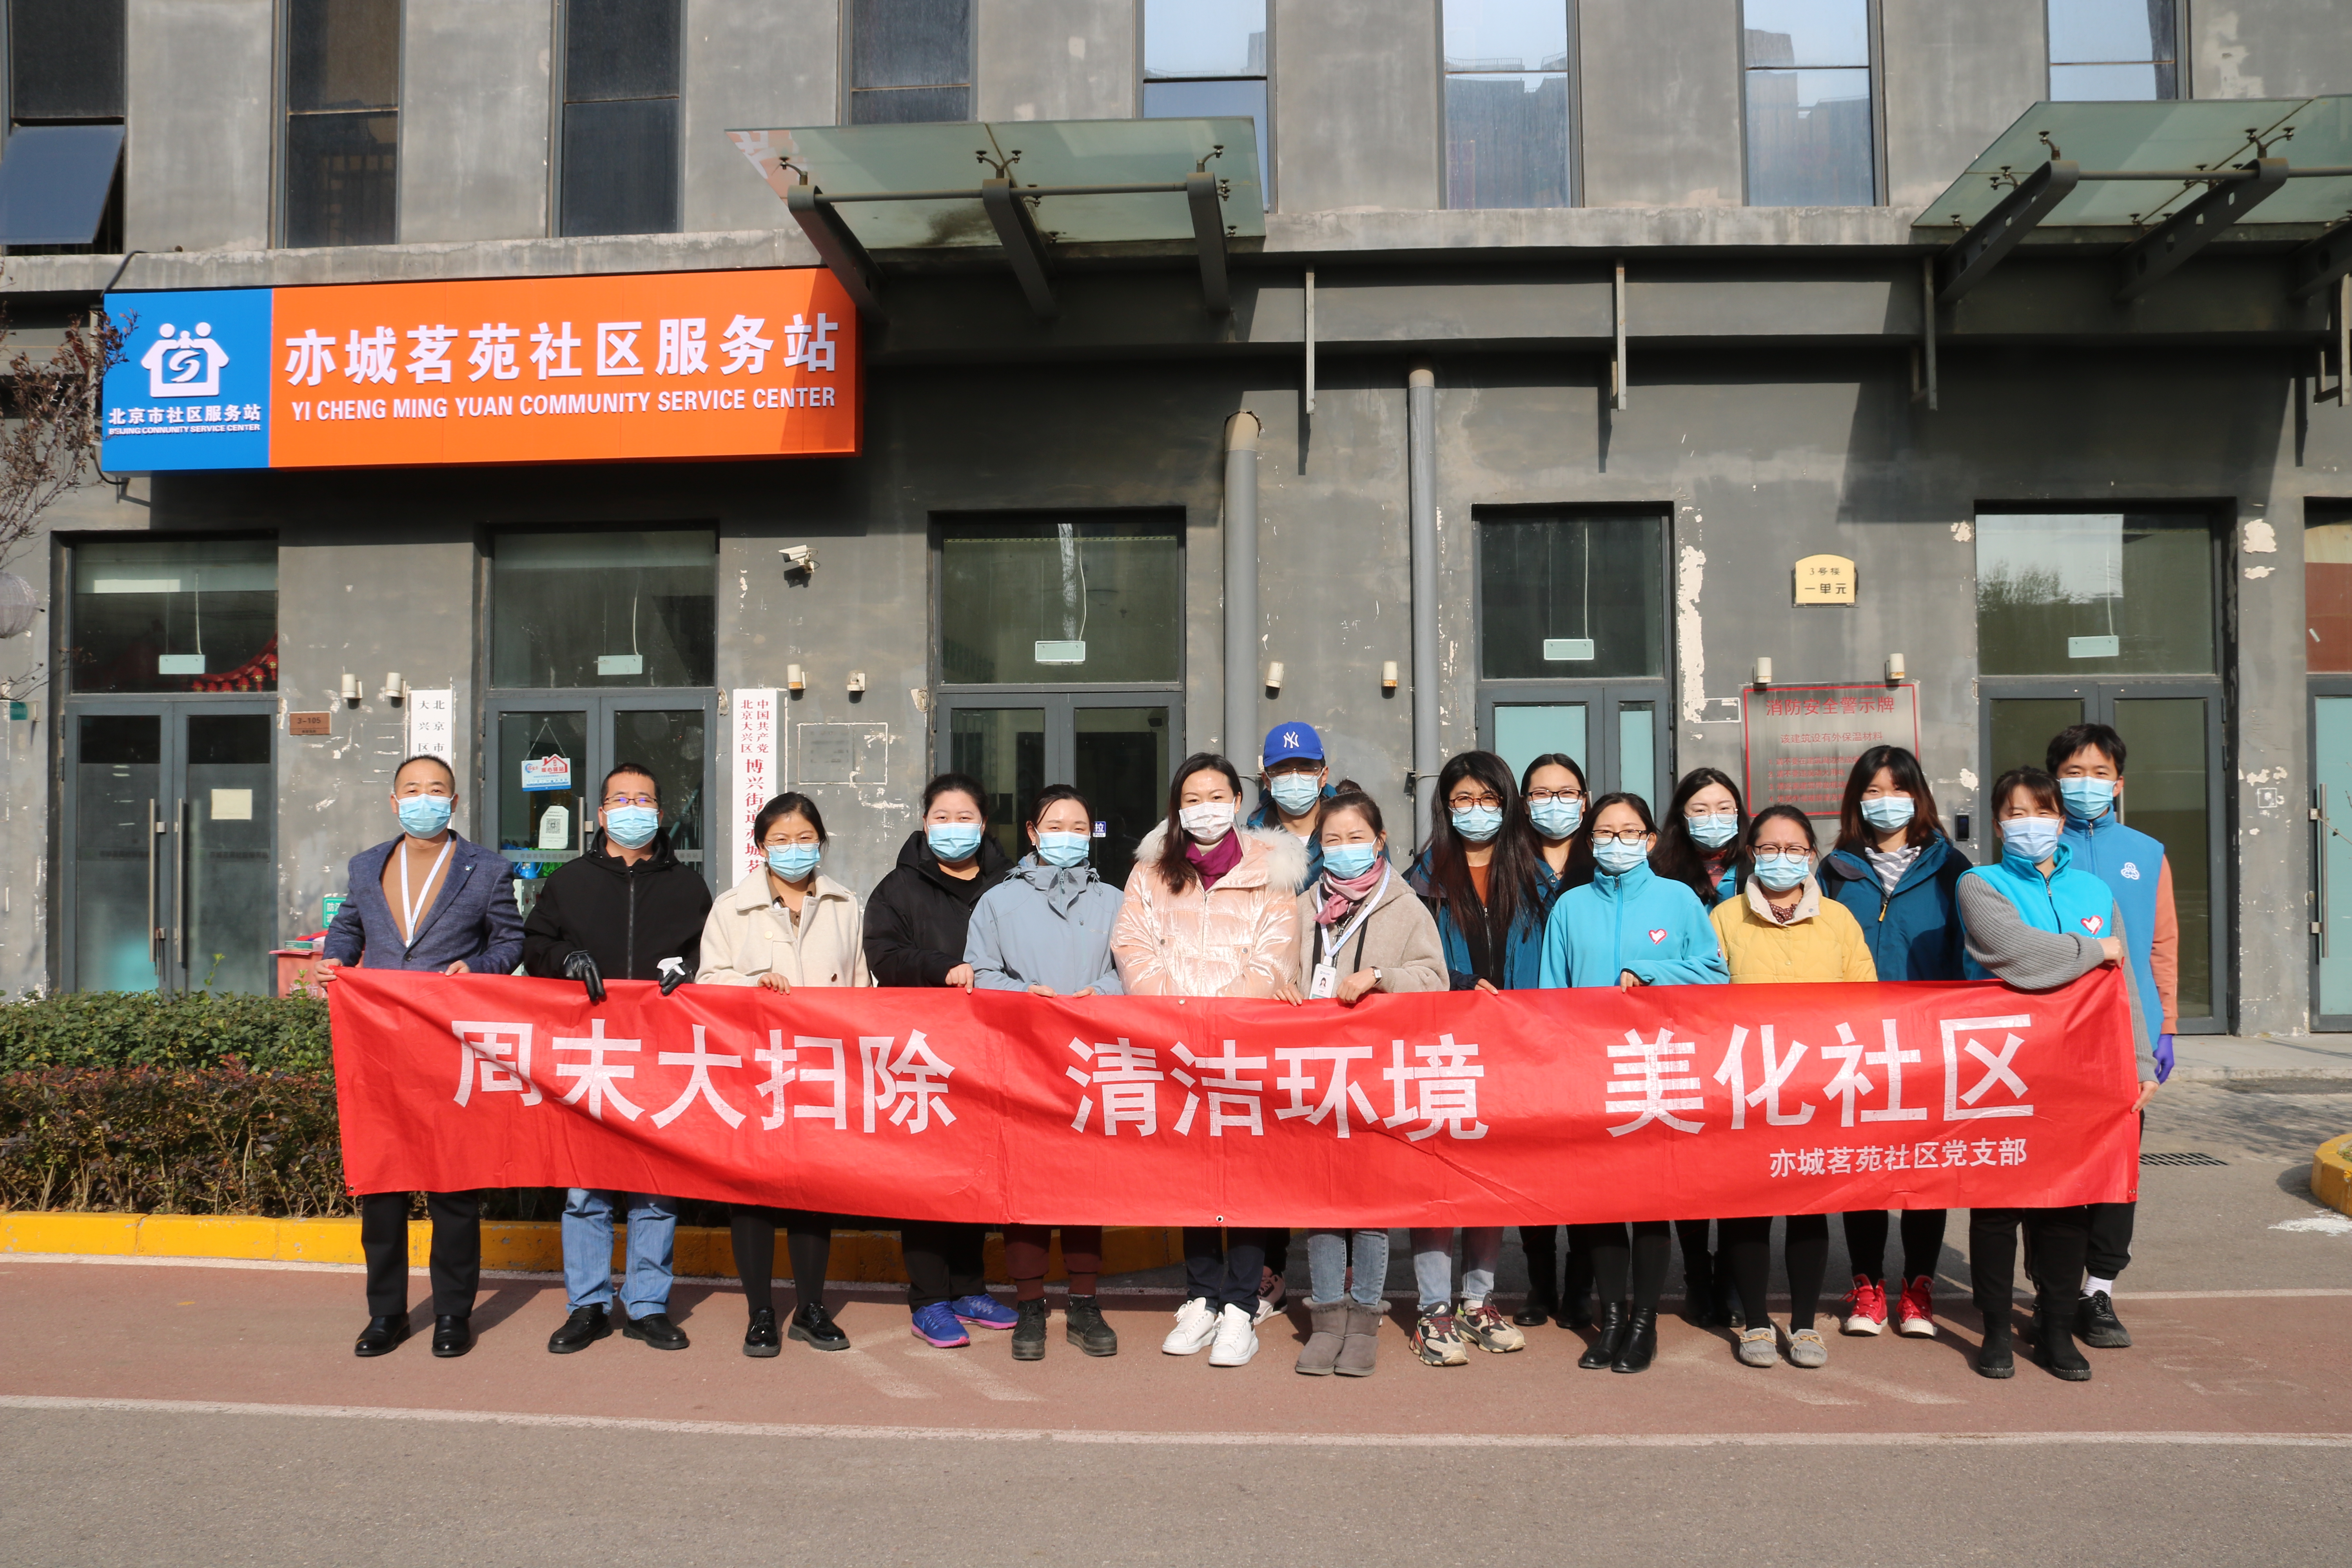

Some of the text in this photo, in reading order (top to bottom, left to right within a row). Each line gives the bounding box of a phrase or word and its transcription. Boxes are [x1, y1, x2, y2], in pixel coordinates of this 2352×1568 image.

[285, 313, 838, 388] 亦城茗苑社区服务站
[108, 403, 261, 425] 北京市社区服务站
[291, 387, 834, 421] YI CHENG MING YUAN COMMUNITY SERVICE CENTER
[226, 423, 261, 432] CENTER
[1809, 567, 1840, 575] 3号楼
[1805, 583, 1847, 594] 一单元
[1766, 696, 1895, 717] 消防安全警示牌
[418, 700, 430, 752] 大兴区
[432, 700, 446, 752] 北京市
[740, 699, 753, 753] 北京大兴区
[757, 699, 769, 753] 中国共产党
[1283, 730, 1300, 749] NY
[1780, 731, 1883, 744] 该建筑设有外保温材料
[1094, 822, 1105, 833] 拉
[452, 1013, 2034, 1142] 周末大扫除 清洁环境 美化社区
[1769, 1136, 2027, 1178] 亦城茗苑社区党支部
